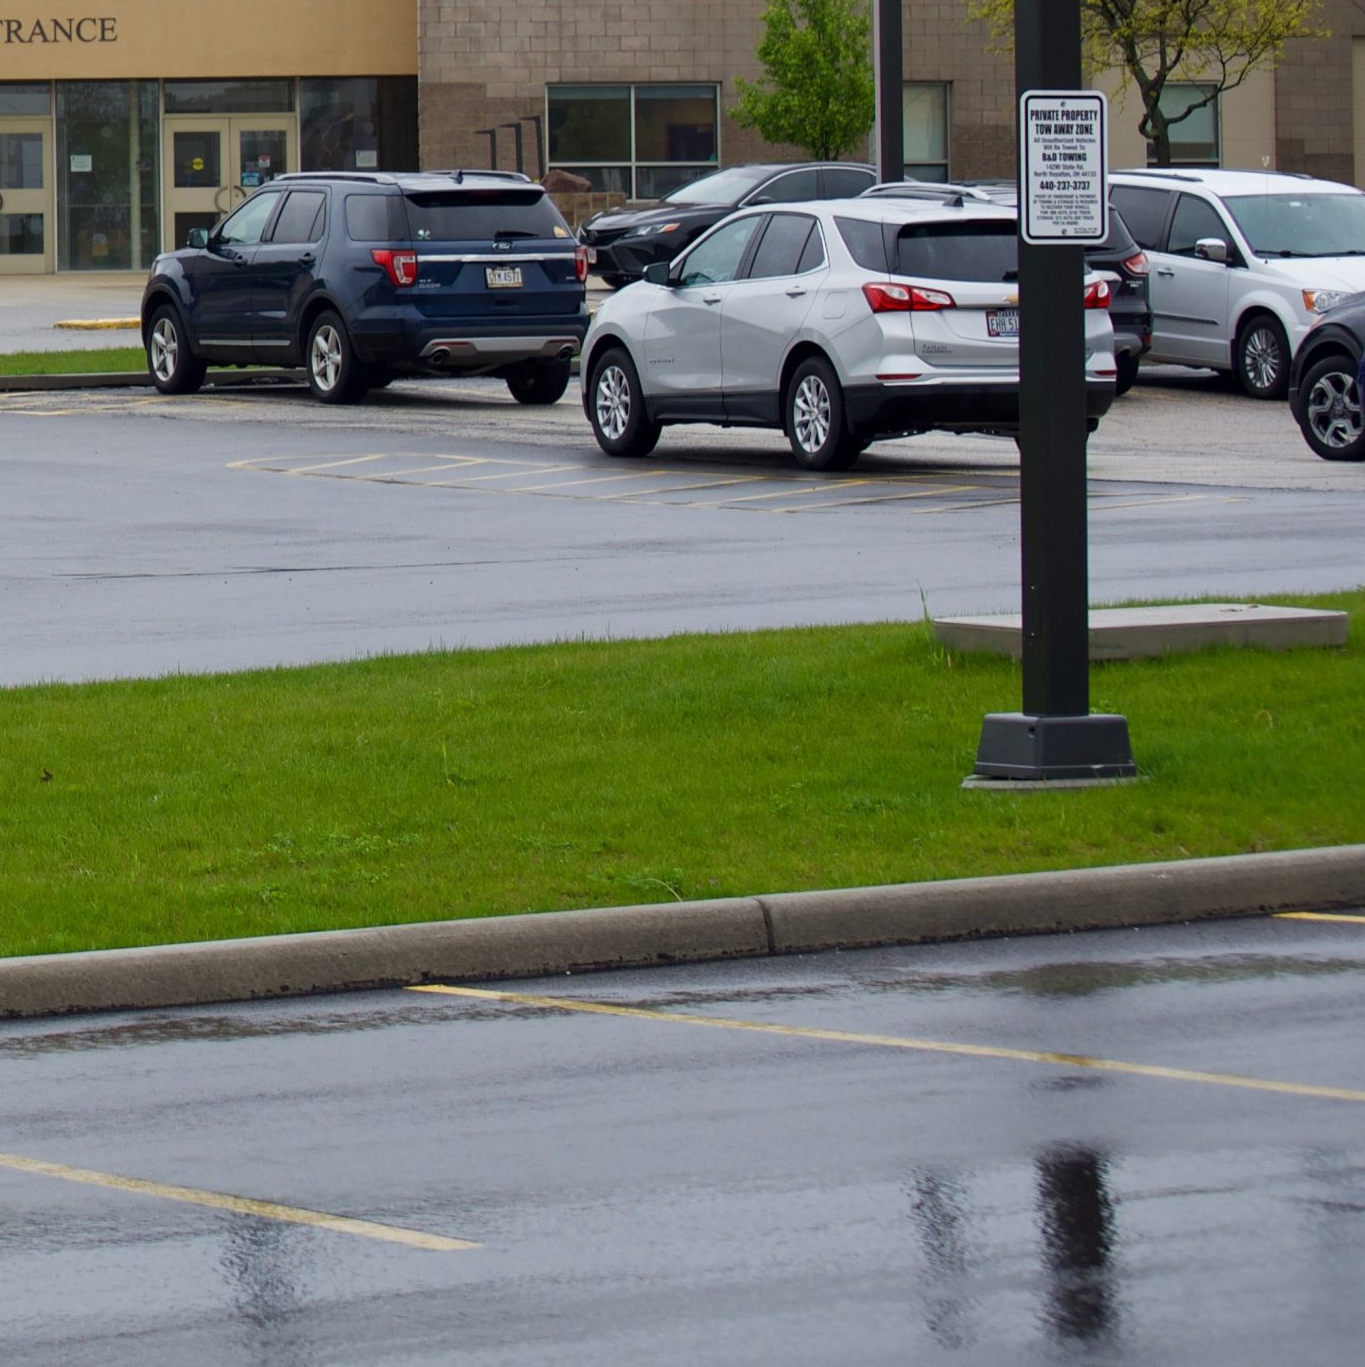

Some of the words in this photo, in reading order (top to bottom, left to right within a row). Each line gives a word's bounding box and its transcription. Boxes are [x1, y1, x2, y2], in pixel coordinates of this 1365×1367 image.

[1030, 109, 1059, 121] PRIVATE
[1061, 109, 1098, 121] PROPERTY
[1035, 123, 1052, 135] TOW
[1053, 123, 1074, 135] AWAY
[1075, 123, 1094, 135] ZONE
[1042, 152, 1057, 162] B&D
[1058, 152, 1087, 162] TOWING
[1039, 180, 1090, 191] 440-237-3737
[1008, 317, 1018, 331] 51
